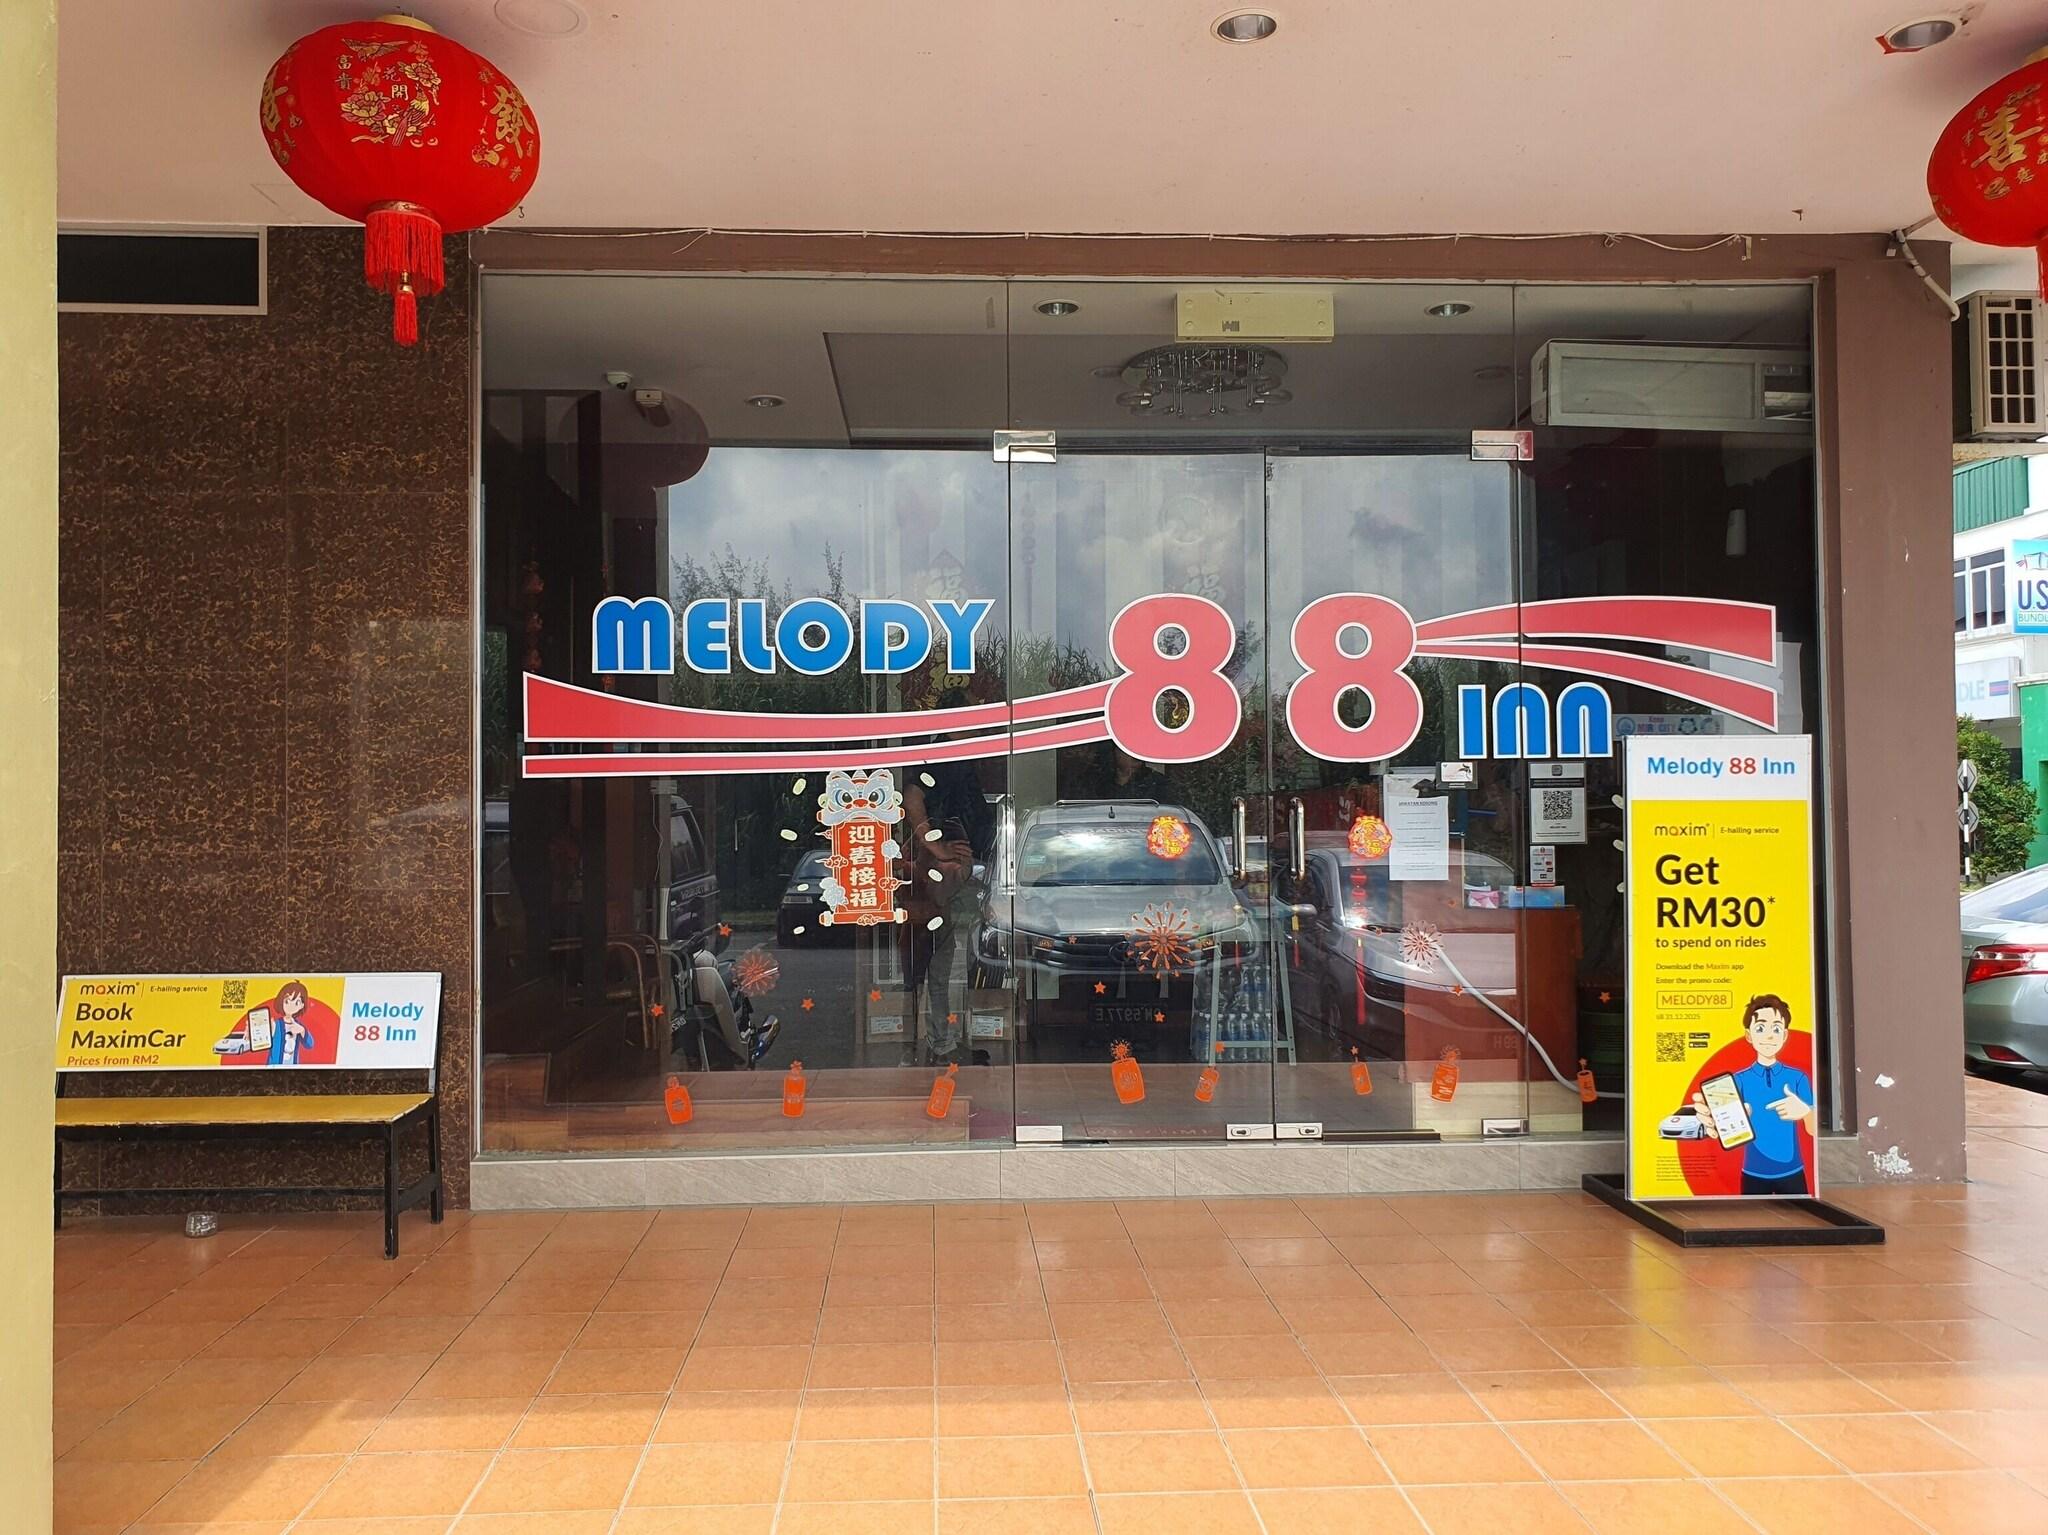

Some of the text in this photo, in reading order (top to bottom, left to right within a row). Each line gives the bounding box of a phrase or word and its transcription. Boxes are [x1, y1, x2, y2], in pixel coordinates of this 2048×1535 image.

[592, 592, 1614, 765] MELODY 88 INN
[1647, 757, 1796, 779] Melody 88 Inn
[1654, 822, 1707, 837] maxim
[1720, 826, 1752, 835] E-hailing
[848, 825, 879, 908] 迎春接福
[1655, 853, 1720, 885] Get
[1656, 936, 1767, 950] to spend on rides
[1731, 964, 1745, 972] app
[80, 981, 208, 996] maxim E-hailing service
[1661, 994, 1728, 1006] MELODY88
[76, 1002, 134, 1021] Book
[352, 1002, 424, 1021] Melody
[71, 1029, 187, 1049] MaximCar
[354, 1025, 417, 1041] 88 Inn
[66, 1055, 159, 1066] Prices from RM2
